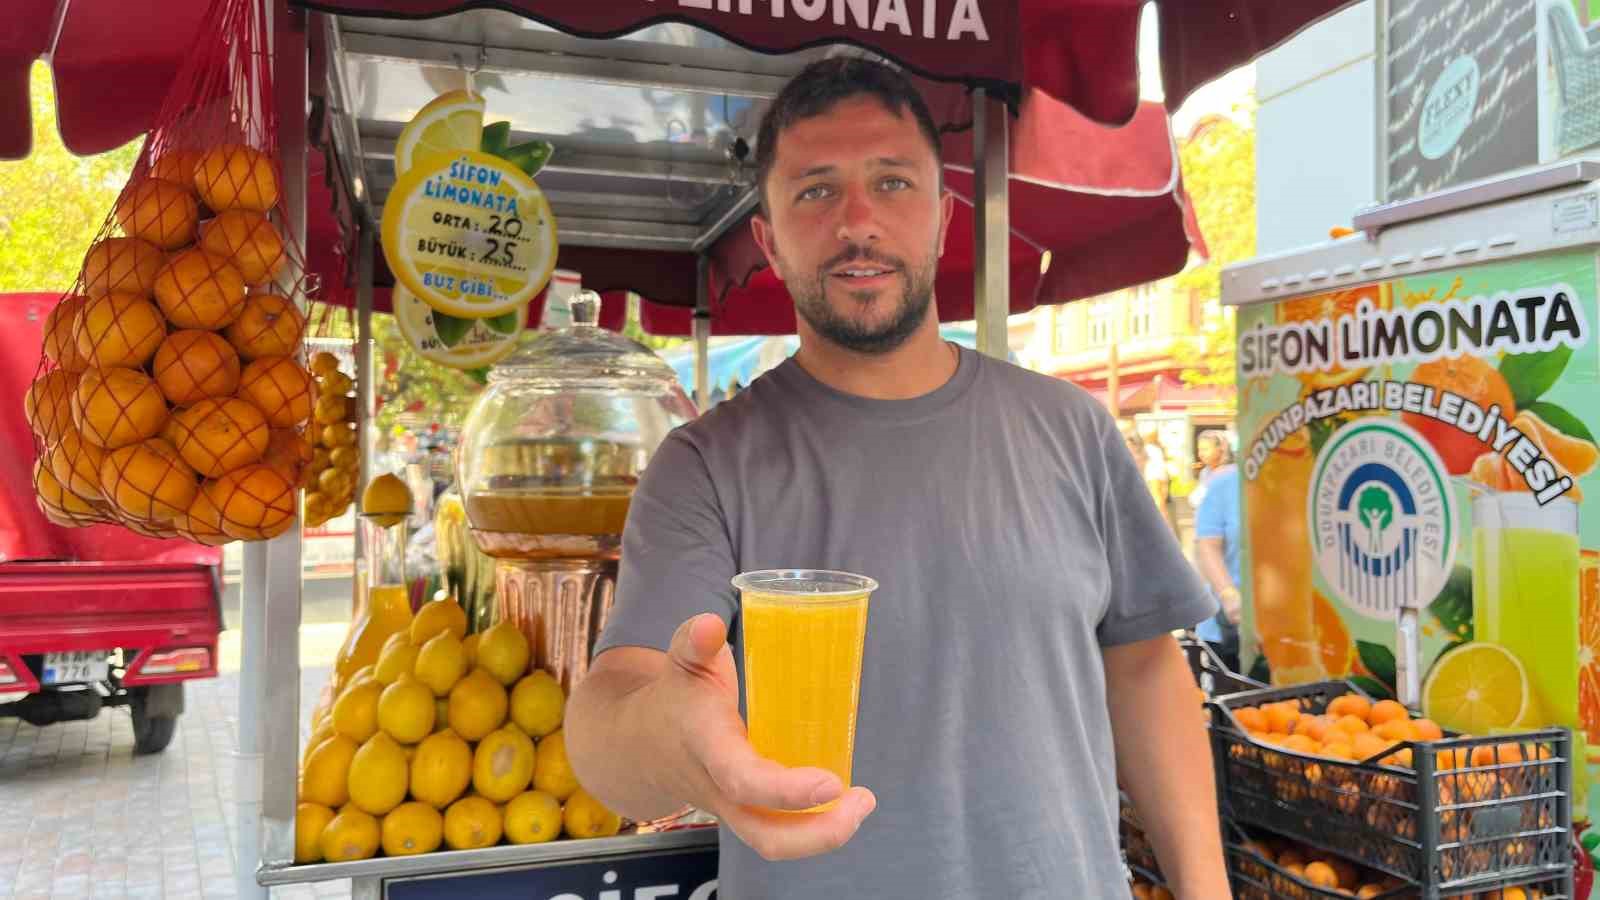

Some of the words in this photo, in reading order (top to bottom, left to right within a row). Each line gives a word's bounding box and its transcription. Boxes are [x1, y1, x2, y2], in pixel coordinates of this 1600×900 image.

[450, 157, 501, 186] SİFON
[424, 176, 518, 217] LİMONATA
[424, 273, 454, 291] BUZ
[1242, 322, 1329, 374] SİFON
[1341, 291, 1582, 361] LİMONATA
[1244, 381, 1378, 480] ODUNPAZARI
[1383, 381, 1573, 506] BELEDİYESİ
